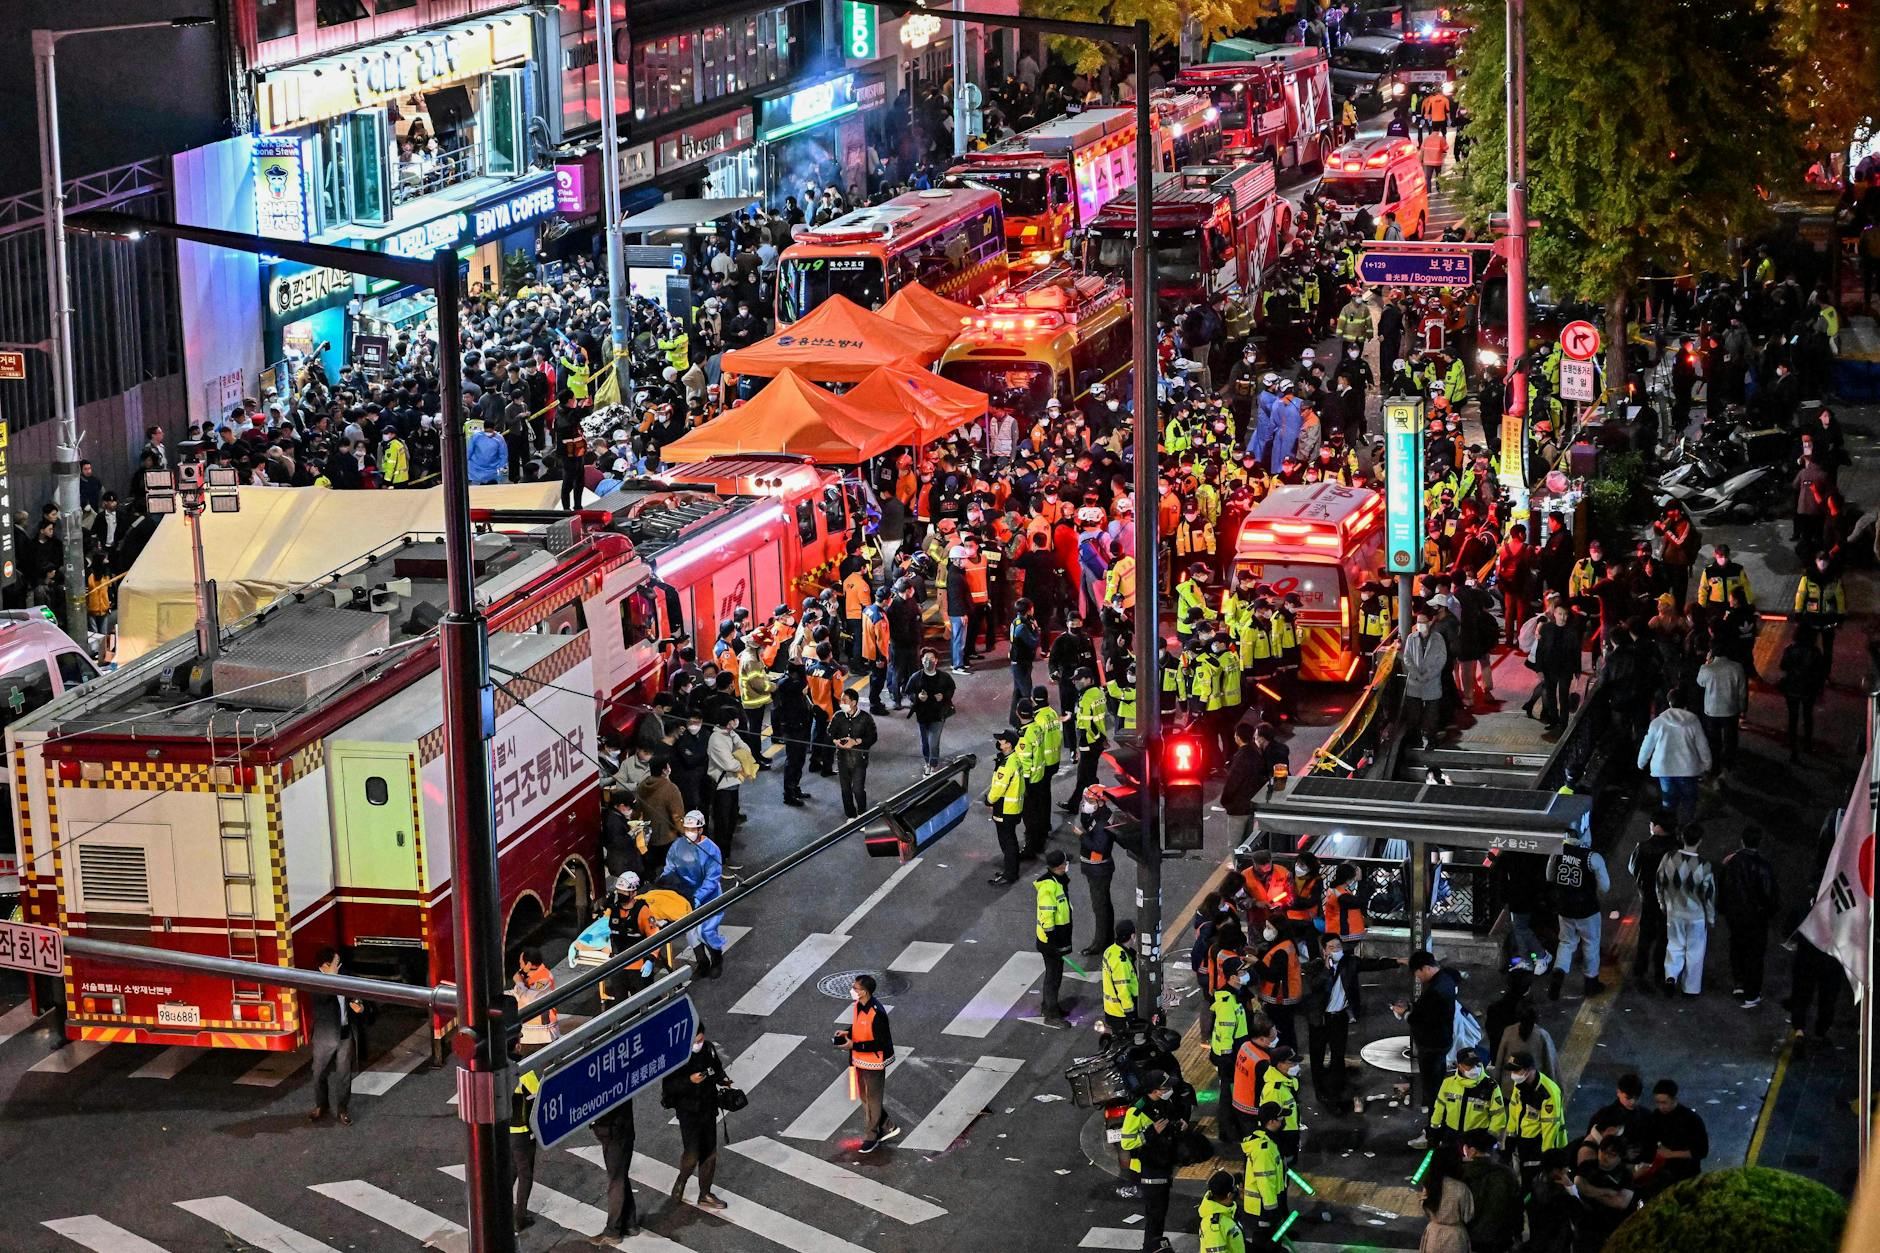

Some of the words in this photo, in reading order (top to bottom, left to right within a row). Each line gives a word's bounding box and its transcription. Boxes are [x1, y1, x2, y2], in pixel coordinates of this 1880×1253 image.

[476, 203, 511, 236] EDIYA
[511, 186, 556, 224] COFFEE
[797, 259, 825, 271] 119
[1428, 258, 1468, 272] 보광로
[1415, 273, 1467, 284] Bogwang-ro
[799, 337, 864, 350] 용산소방서
[1508, 838, 1539, 851] 용산구
[1562, 854, 1581, 868] PAYNE
[1557, 864, 1583, 888] 23
[81, 982, 122, 993] 서울특별시
[124, 984, 173, 996] 소방재난본부
[667, 1018, 688, 1048] 177
[588, 1033, 644, 1082] 이태원로
[542, 1093, 564, 1125] 181
[569, 1081, 623, 1125] Itaewon-ro
